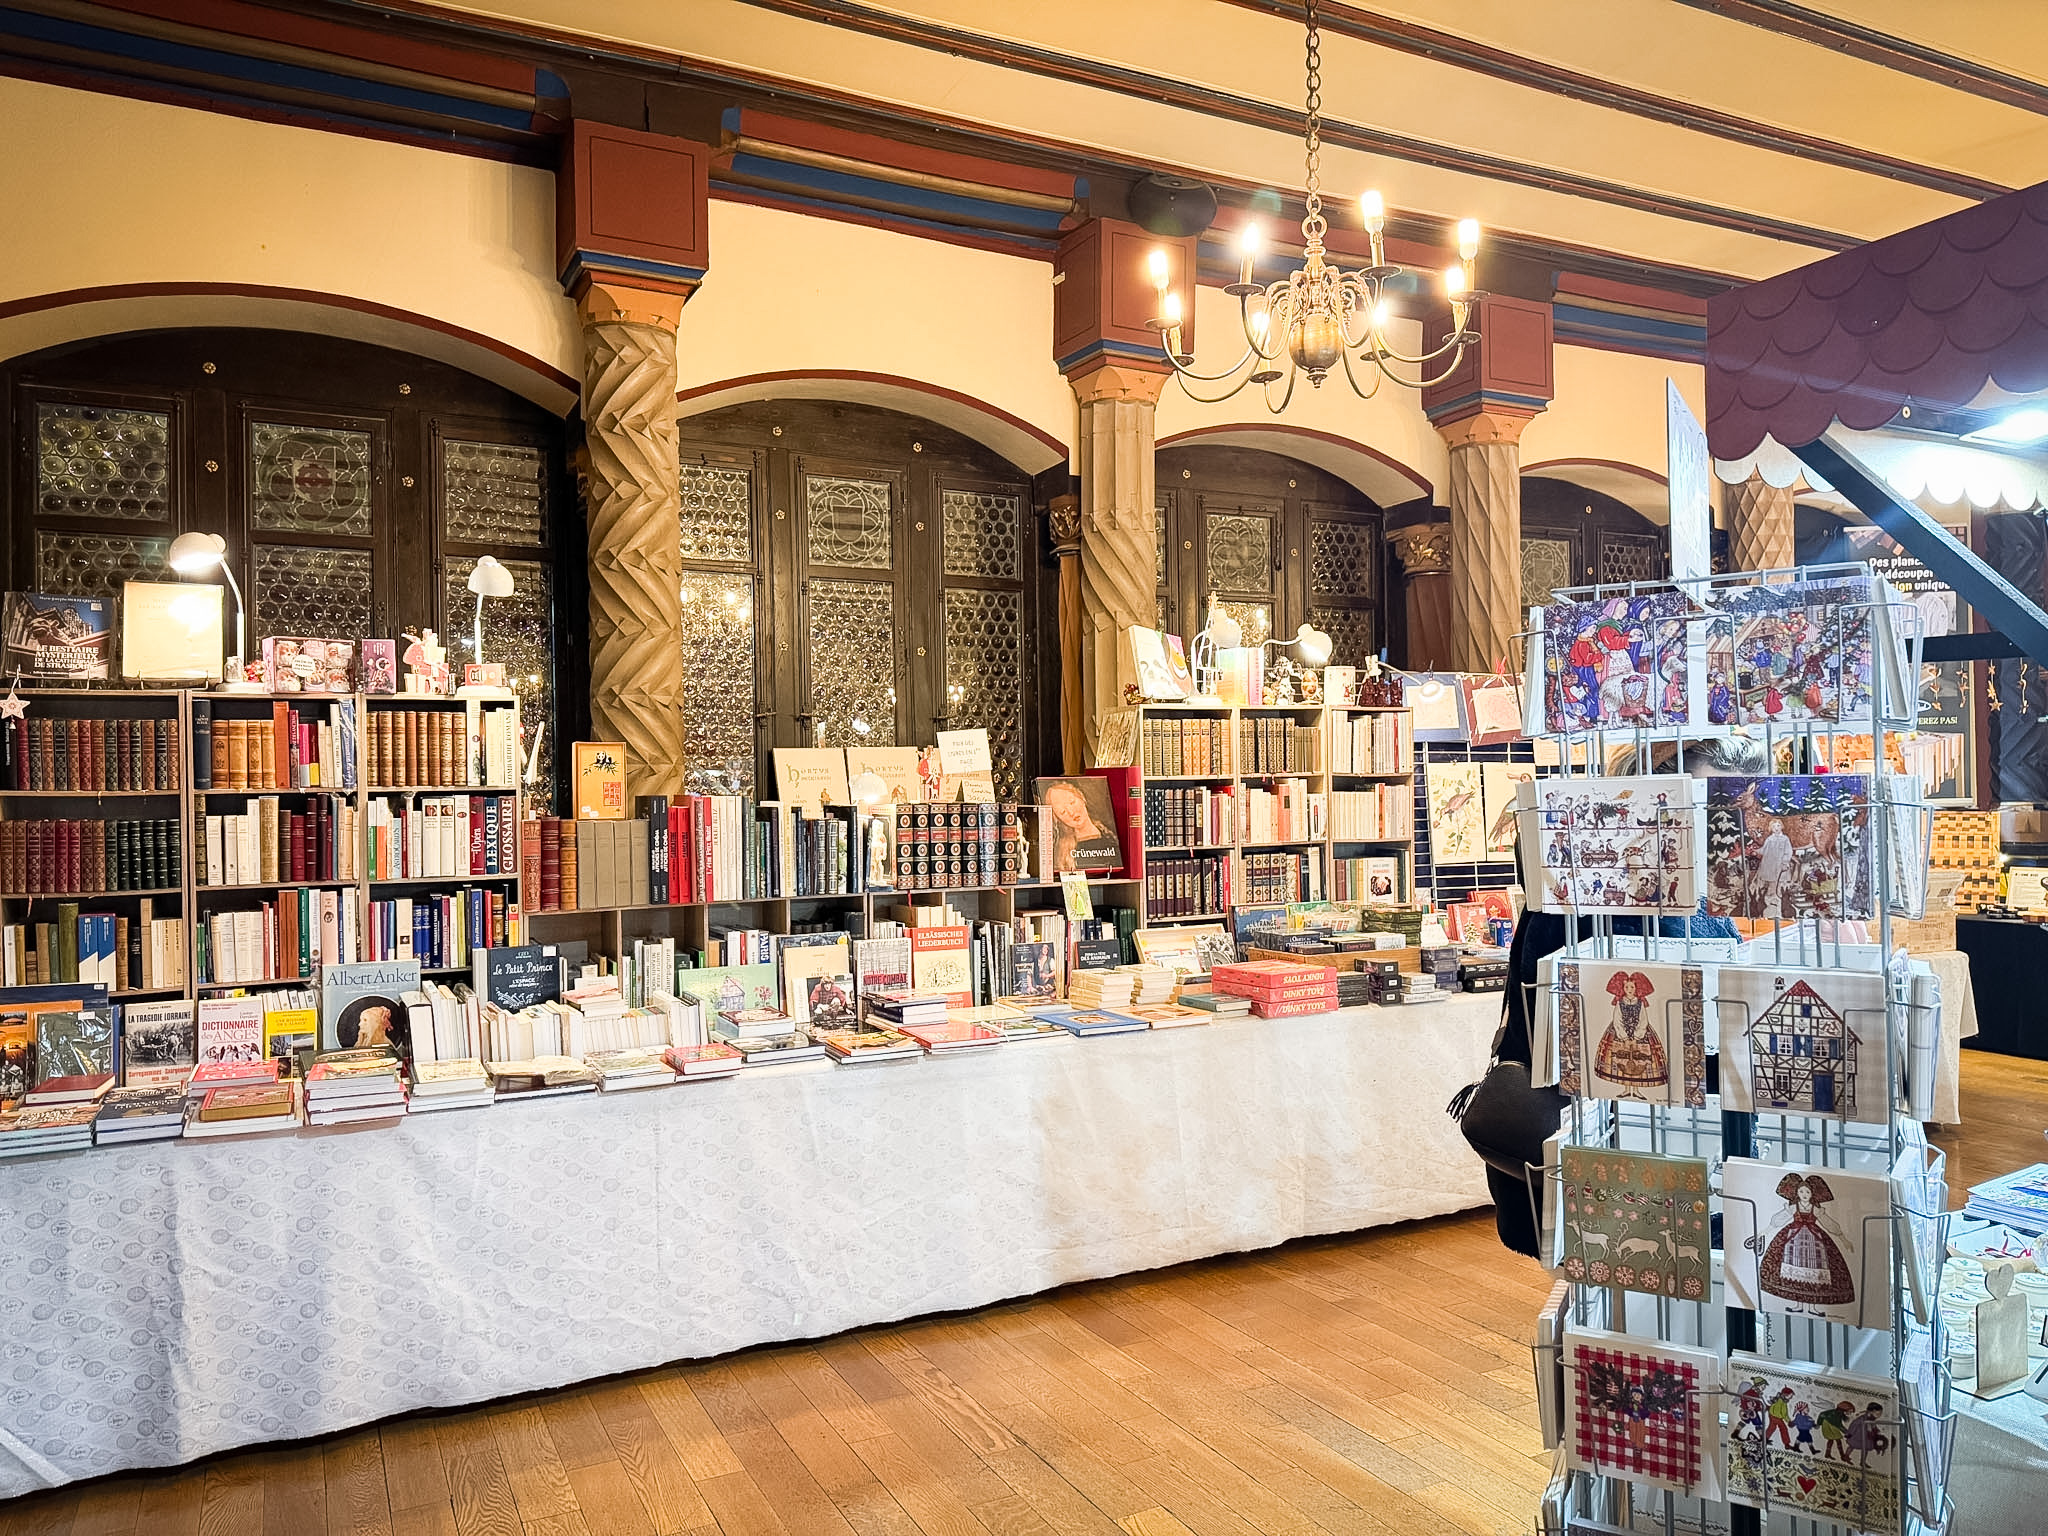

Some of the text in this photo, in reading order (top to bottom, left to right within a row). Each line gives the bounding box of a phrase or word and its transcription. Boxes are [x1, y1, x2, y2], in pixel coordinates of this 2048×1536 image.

[1869, 556, 1924, 568] Des planc
[50, 646, 99, 654] BESTIAIRE
[486, 806, 498, 866] LEXIQUE
[502, 800, 513, 871] GLOSSAIRE
[1070, 846, 1115, 858] Grünewald
[918, 931, 963, 939] ELSÄSSISCHES
[760, 933, 769, 963] PARIS
[493, 962, 553, 975] Le Petit Prince
[326, 968, 417, 986] Albert Anker
[1283, 986, 1325, 998] DINKY TOYS
[1281, 1002, 1326, 1013] DINKY TOYS
[202, 1020, 258, 1031] DICTIONNAIRE
[213, 1029, 259, 1041] ANGES
